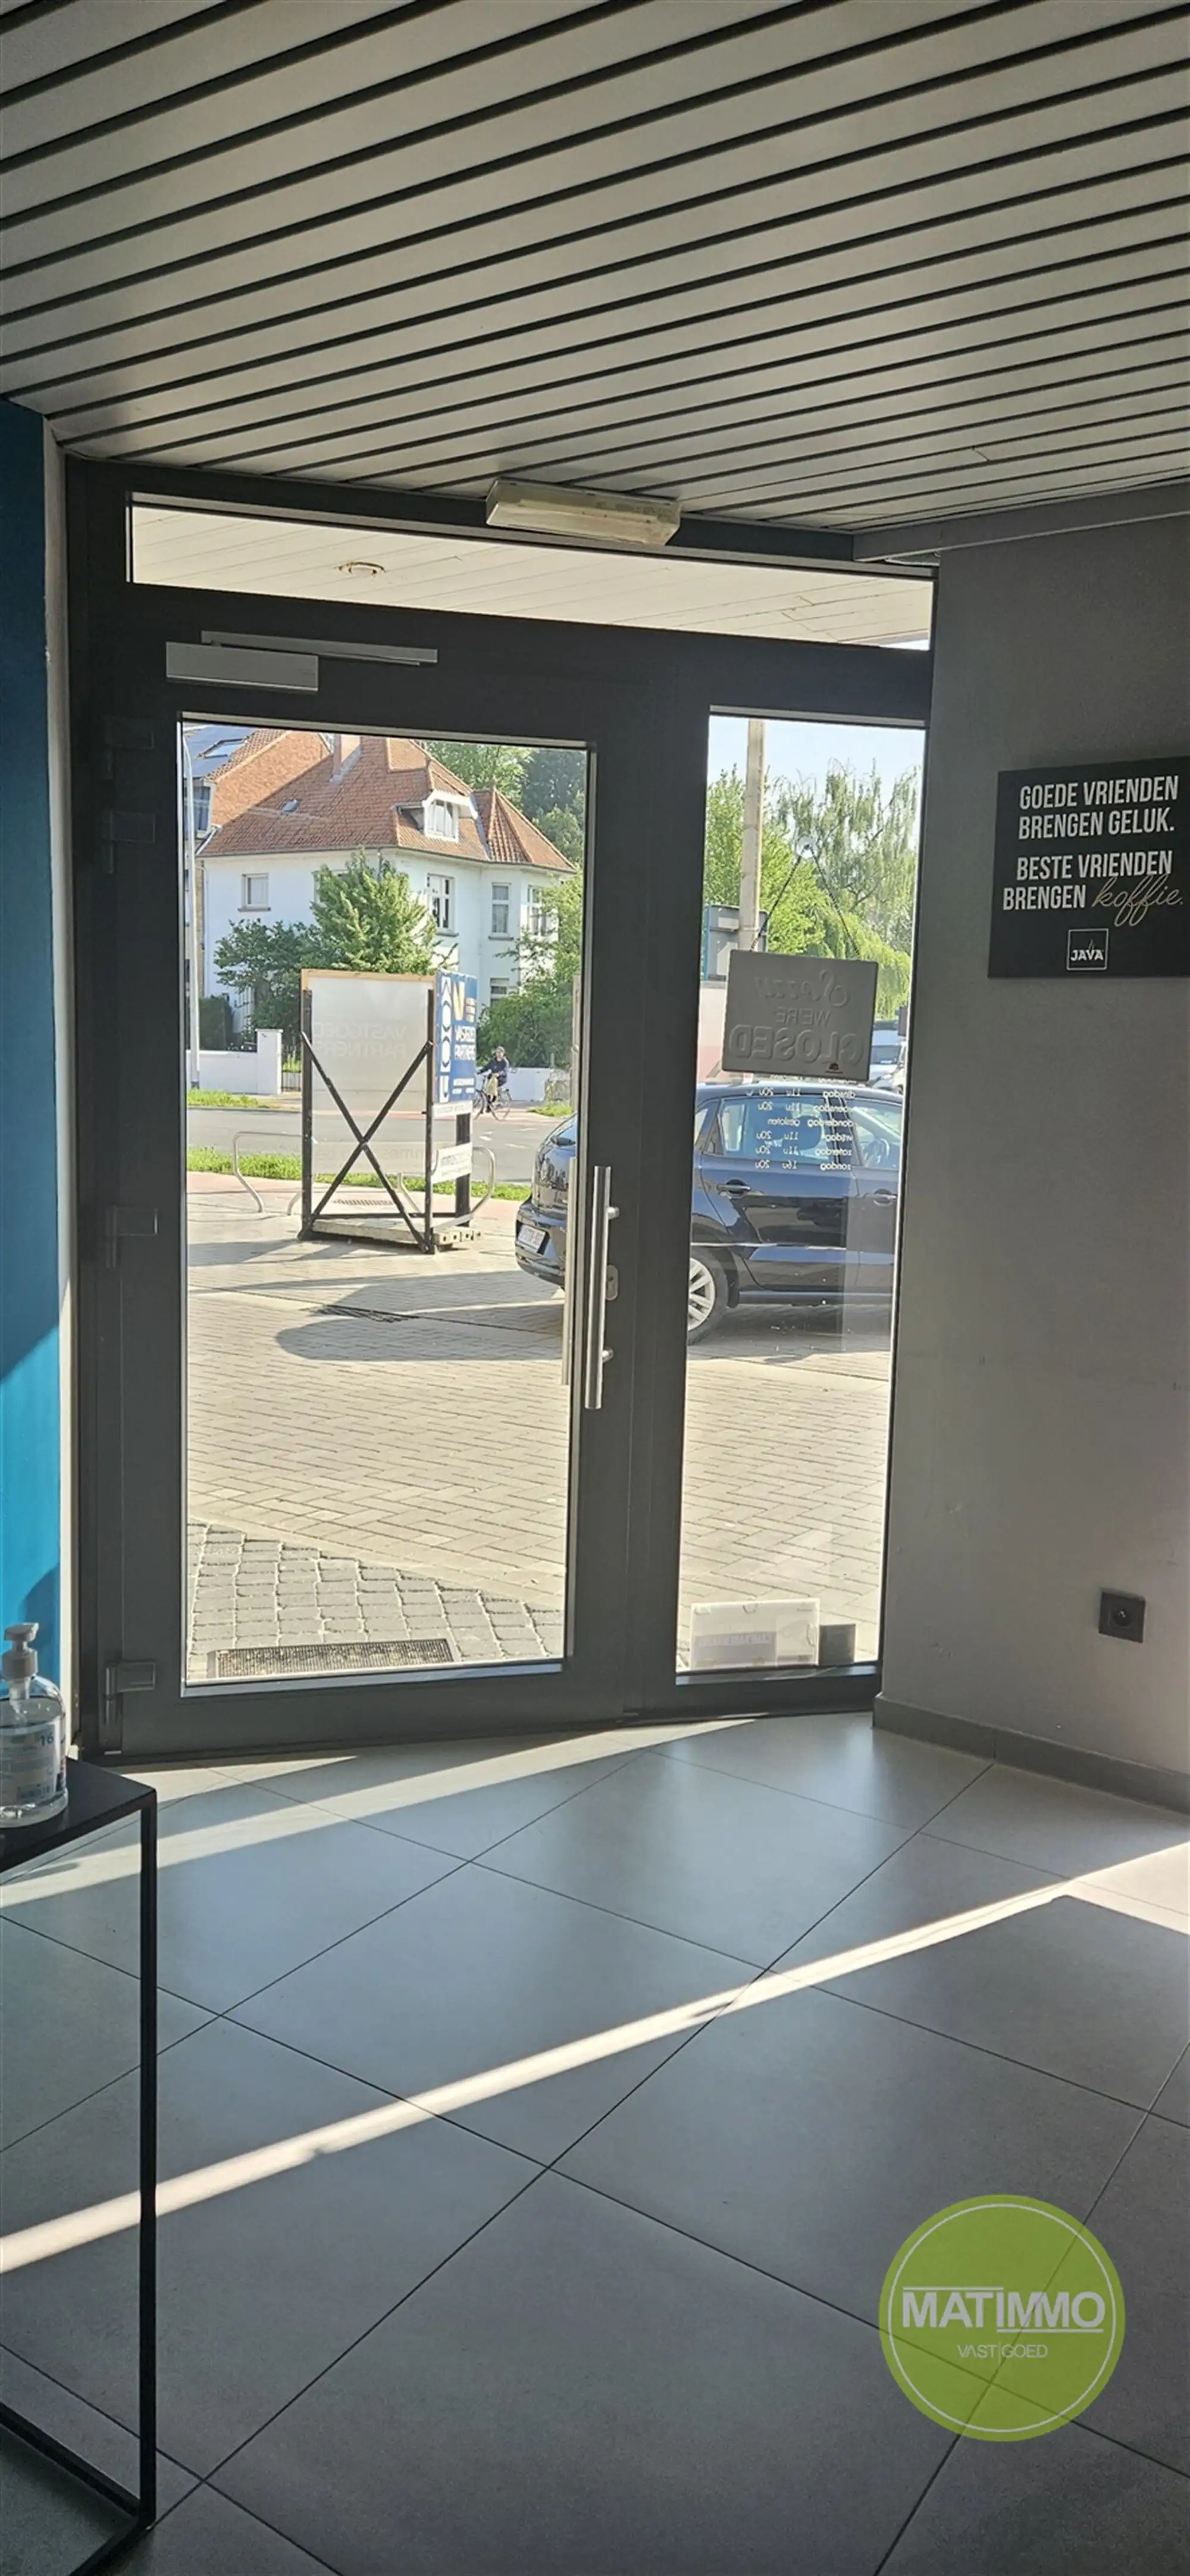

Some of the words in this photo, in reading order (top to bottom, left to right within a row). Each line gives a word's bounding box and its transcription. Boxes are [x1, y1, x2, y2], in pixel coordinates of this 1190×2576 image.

[1019, 782, 1078, 810] GOEDE
[1083, 775, 1179, 806] VRIENDEN
[1019, 812, 1104, 840] BRENGEN
[1108, 807, 1175, 835] GELUK.
[1016, 855, 1073, 881] BESTE
[1078, 850, 1173, 879] VRIENDEN
[1003, 885, 1086, 910] BRENGEN
[1070, 949, 1104, 962] JAVA
